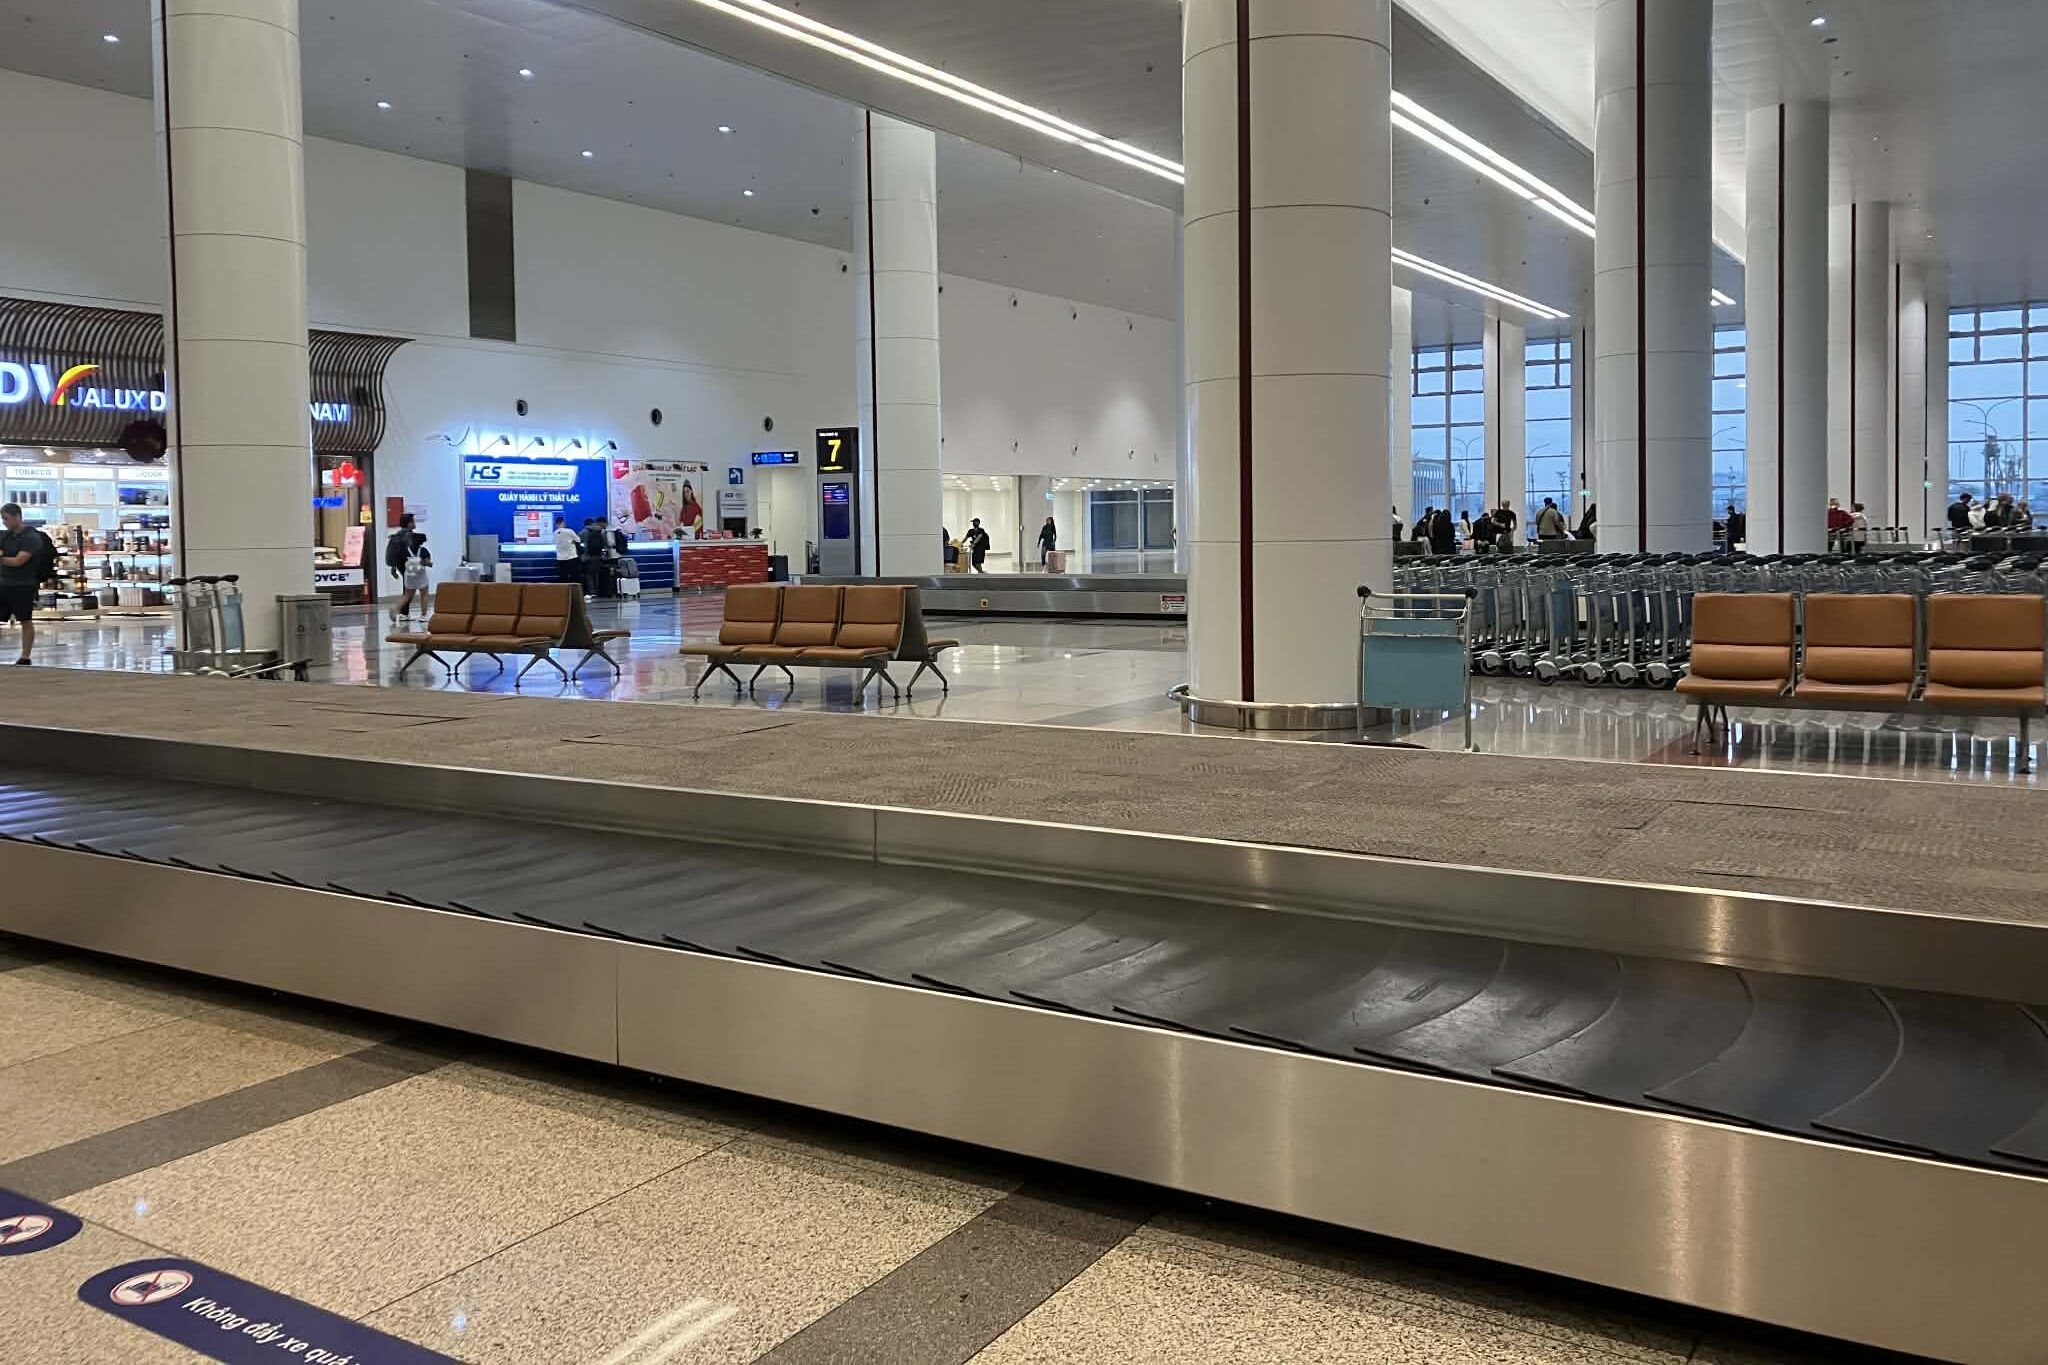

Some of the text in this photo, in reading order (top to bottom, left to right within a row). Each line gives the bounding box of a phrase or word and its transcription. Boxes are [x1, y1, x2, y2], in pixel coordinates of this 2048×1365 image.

[70, 386, 146, 410] JALUX
[828, 439, 841, 462] 7
[470, 465, 502, 479] HCS
[314, 572, 350, 582] OYCE'
[181, 1296, 248, 1330] Không
[242, 1322, 284, 1344] đẩy
[277, 1337, 309, 1352] xe
